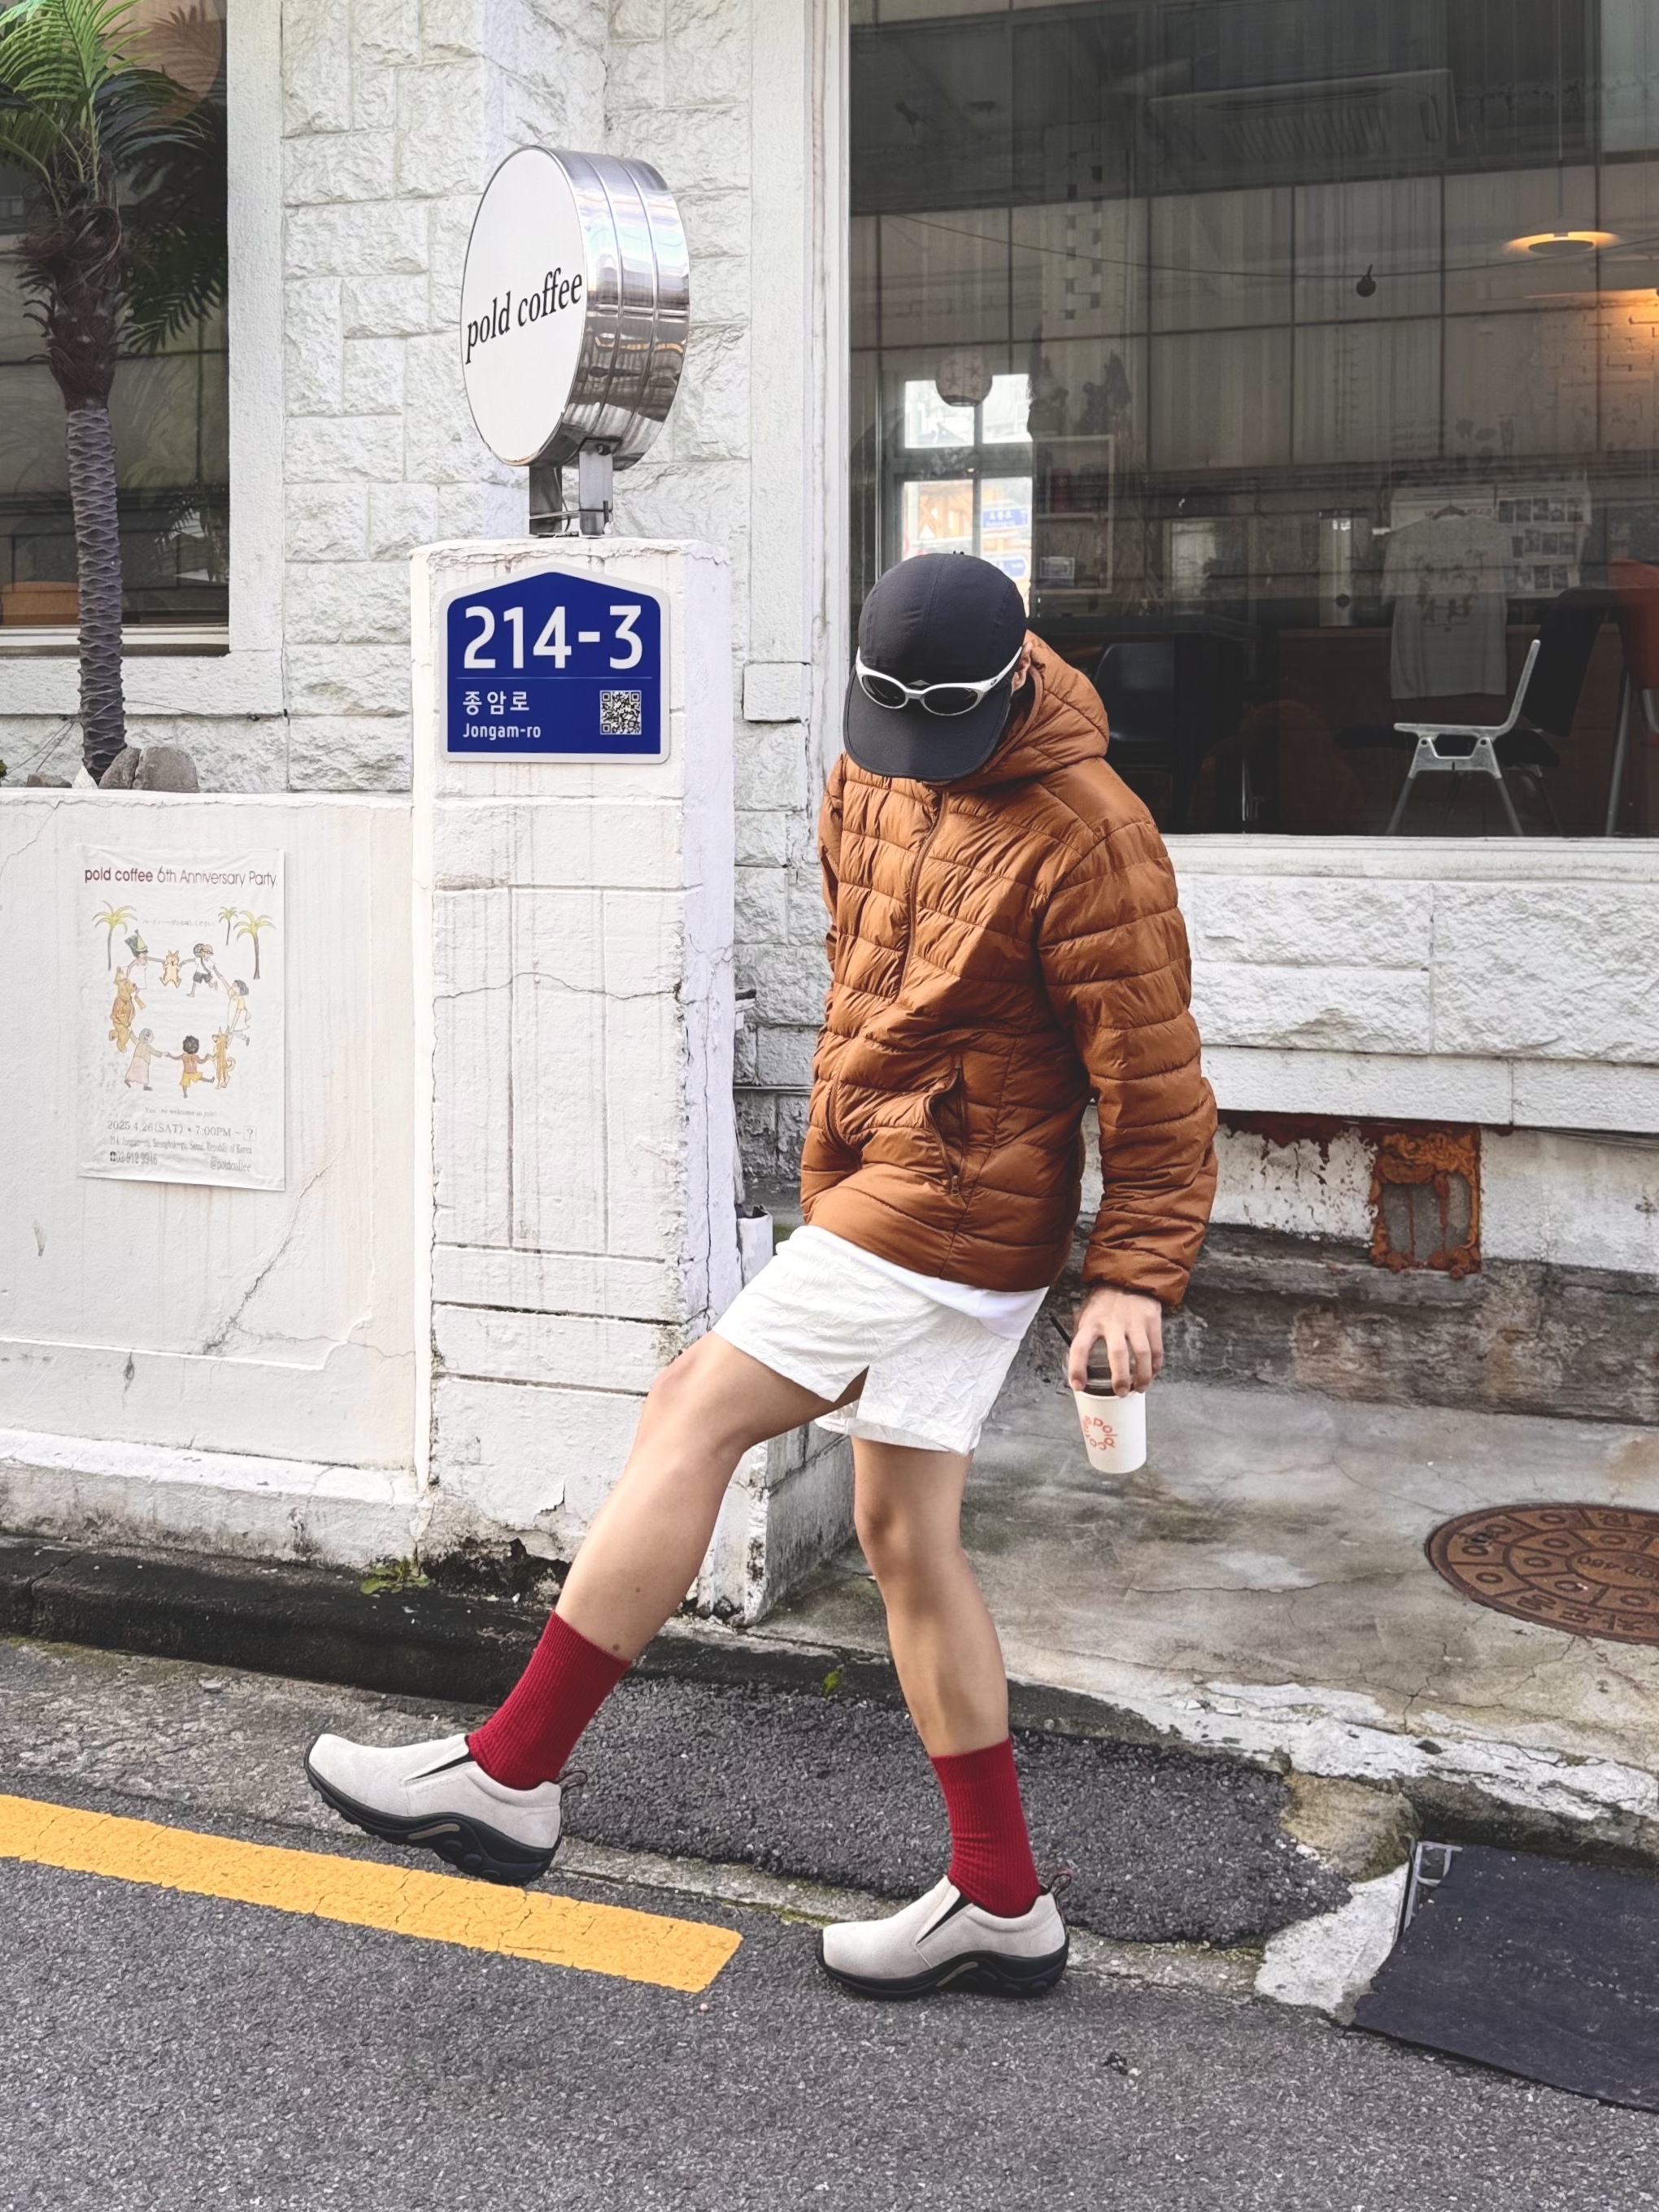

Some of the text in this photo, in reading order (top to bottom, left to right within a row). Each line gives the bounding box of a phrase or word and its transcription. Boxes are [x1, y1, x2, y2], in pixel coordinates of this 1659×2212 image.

[465, 267, 583, 364] pold coffee
[464, 605, 642, 669] 214-3
[463, 691, 529, 716] 종암로
[463, 723, 541, 741] Jongam-ro
[85, 865, 276, 889] pold coffee 6th Anniversary Party
[1093, 1417, 1118, 1448] pold
